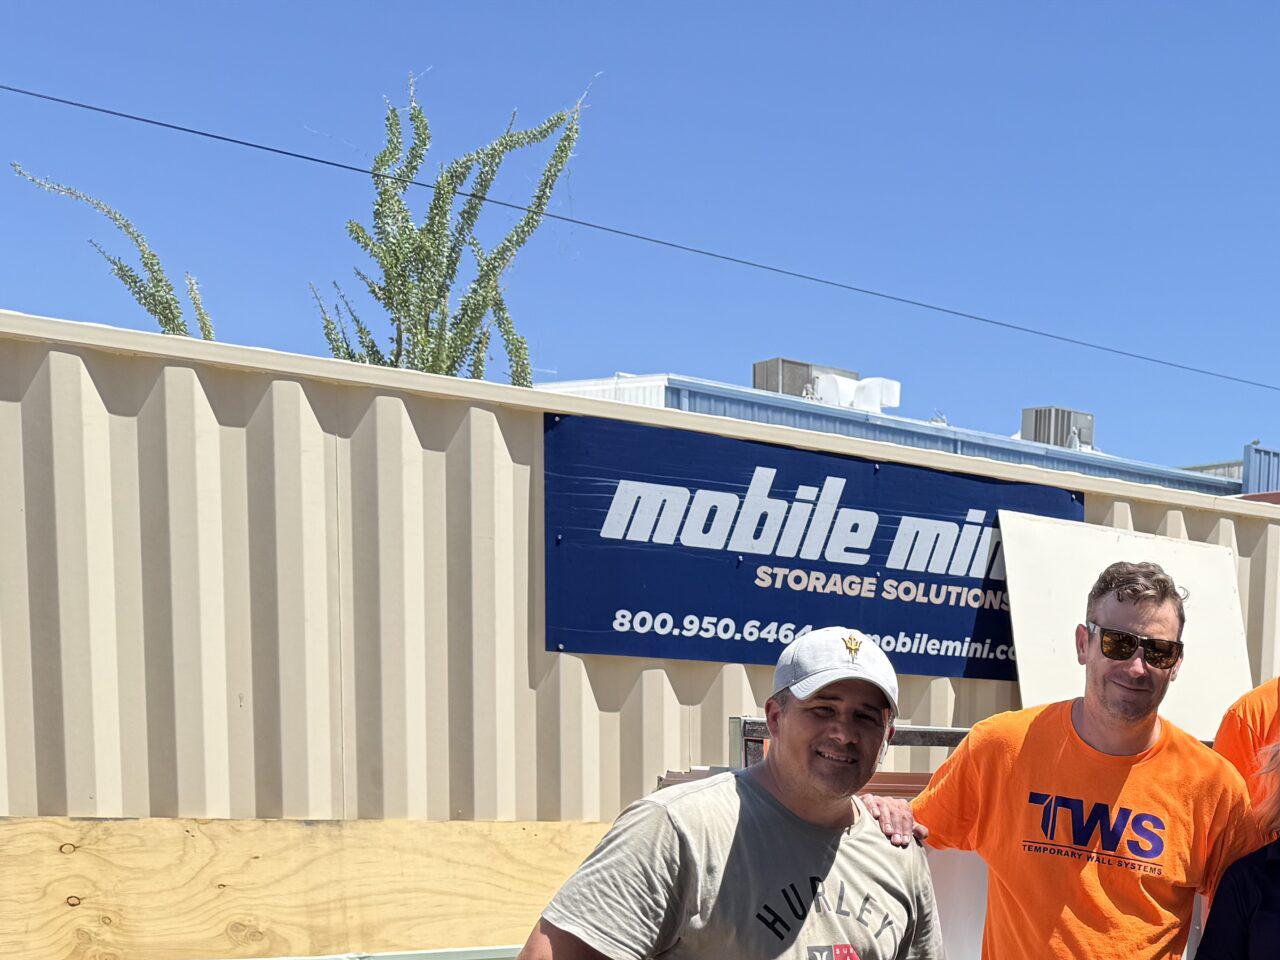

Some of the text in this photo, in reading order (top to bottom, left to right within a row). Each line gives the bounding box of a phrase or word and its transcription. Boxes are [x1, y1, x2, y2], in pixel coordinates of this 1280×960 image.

[600, 466, 1007, 580] mobile min
[754, 565, 877, 598] STORAGE
[1028, 791, 1166, 859] TWS
[1022, 844, 1162, 876] TEMPORARY WALL SYSTEMS
[755, 876, 894, 941] HURLEY
